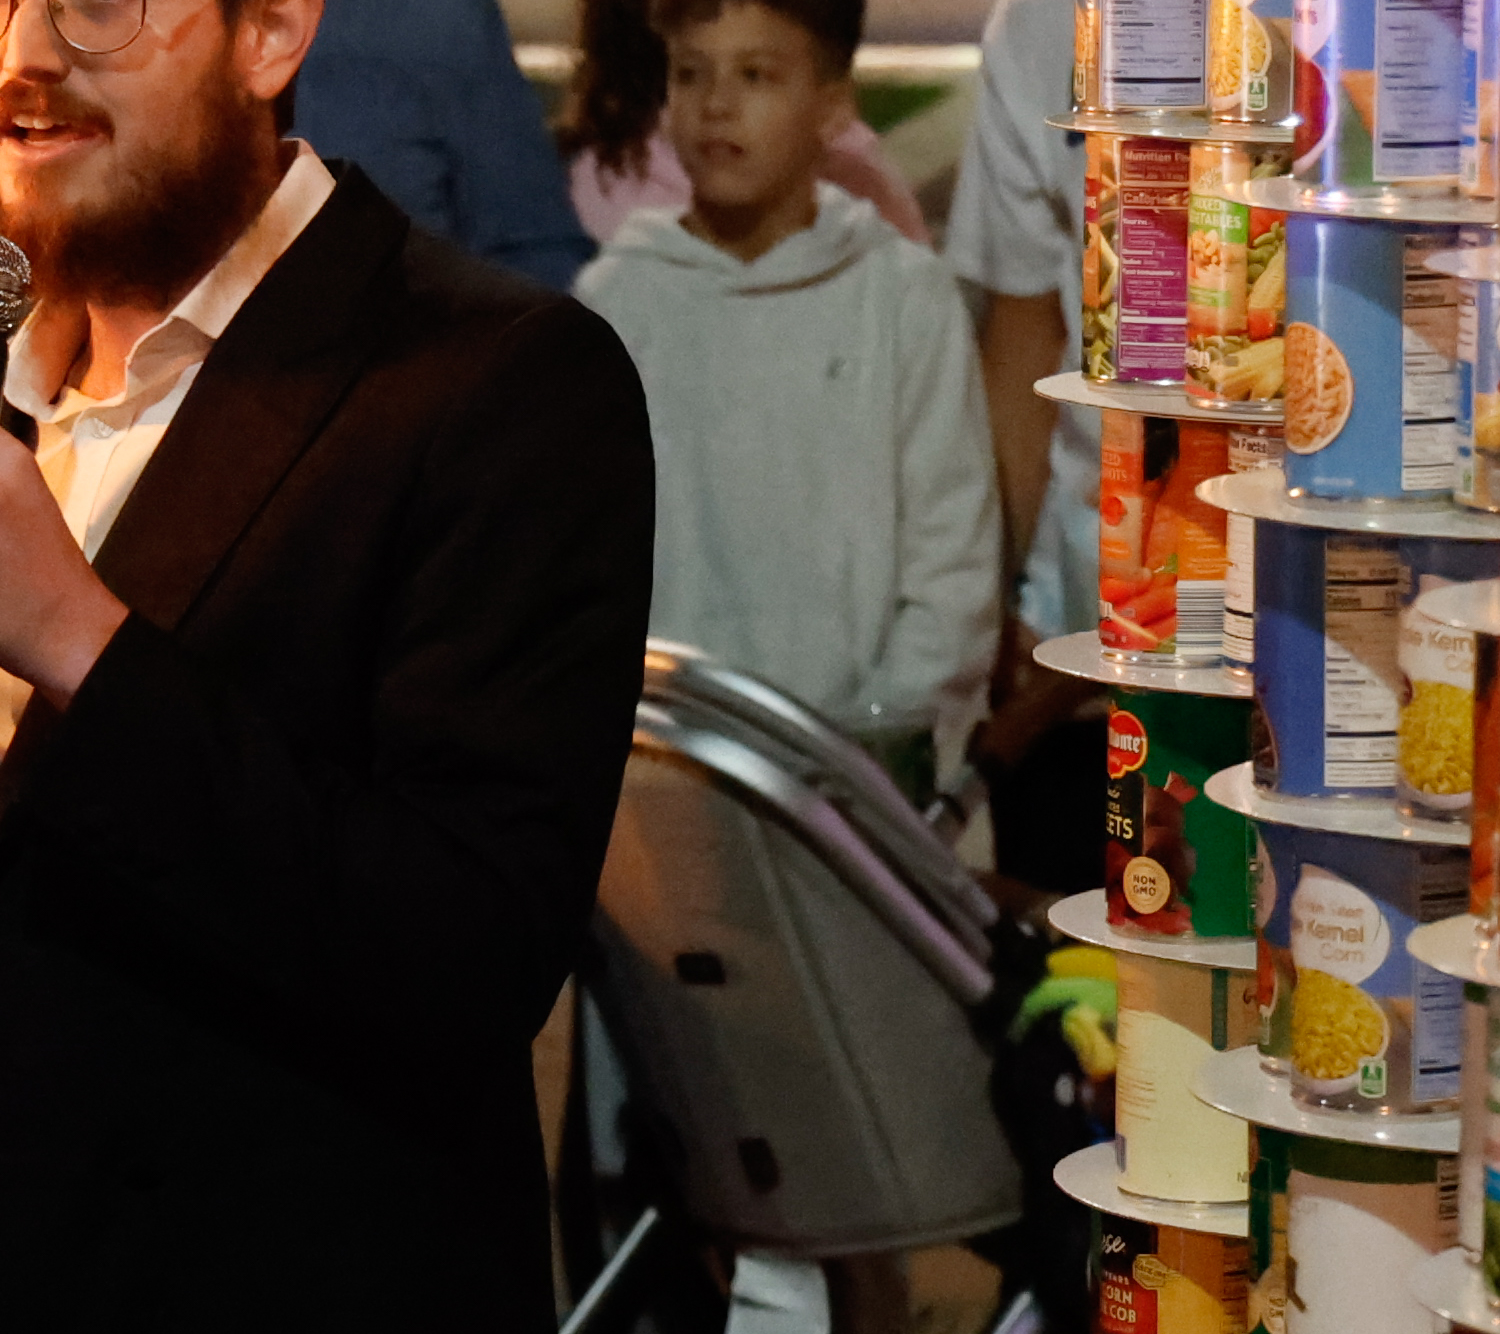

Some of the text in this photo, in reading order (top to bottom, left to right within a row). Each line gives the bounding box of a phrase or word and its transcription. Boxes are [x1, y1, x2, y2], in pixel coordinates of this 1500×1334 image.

[1191, 197, 1223, 211] IXED
[1190, 213, 1243, 229] ETABLES
[1106, 812, 1134, 839] ETS
[1133, 874, 1157, 886] NON
[1133, 885, 1157, 897] GMO
[1306, 919, 1364, 943] Kernel
[1106, 1286, 1133, 1305] ORN
[1110, 1306, 1137, 1324] COB
